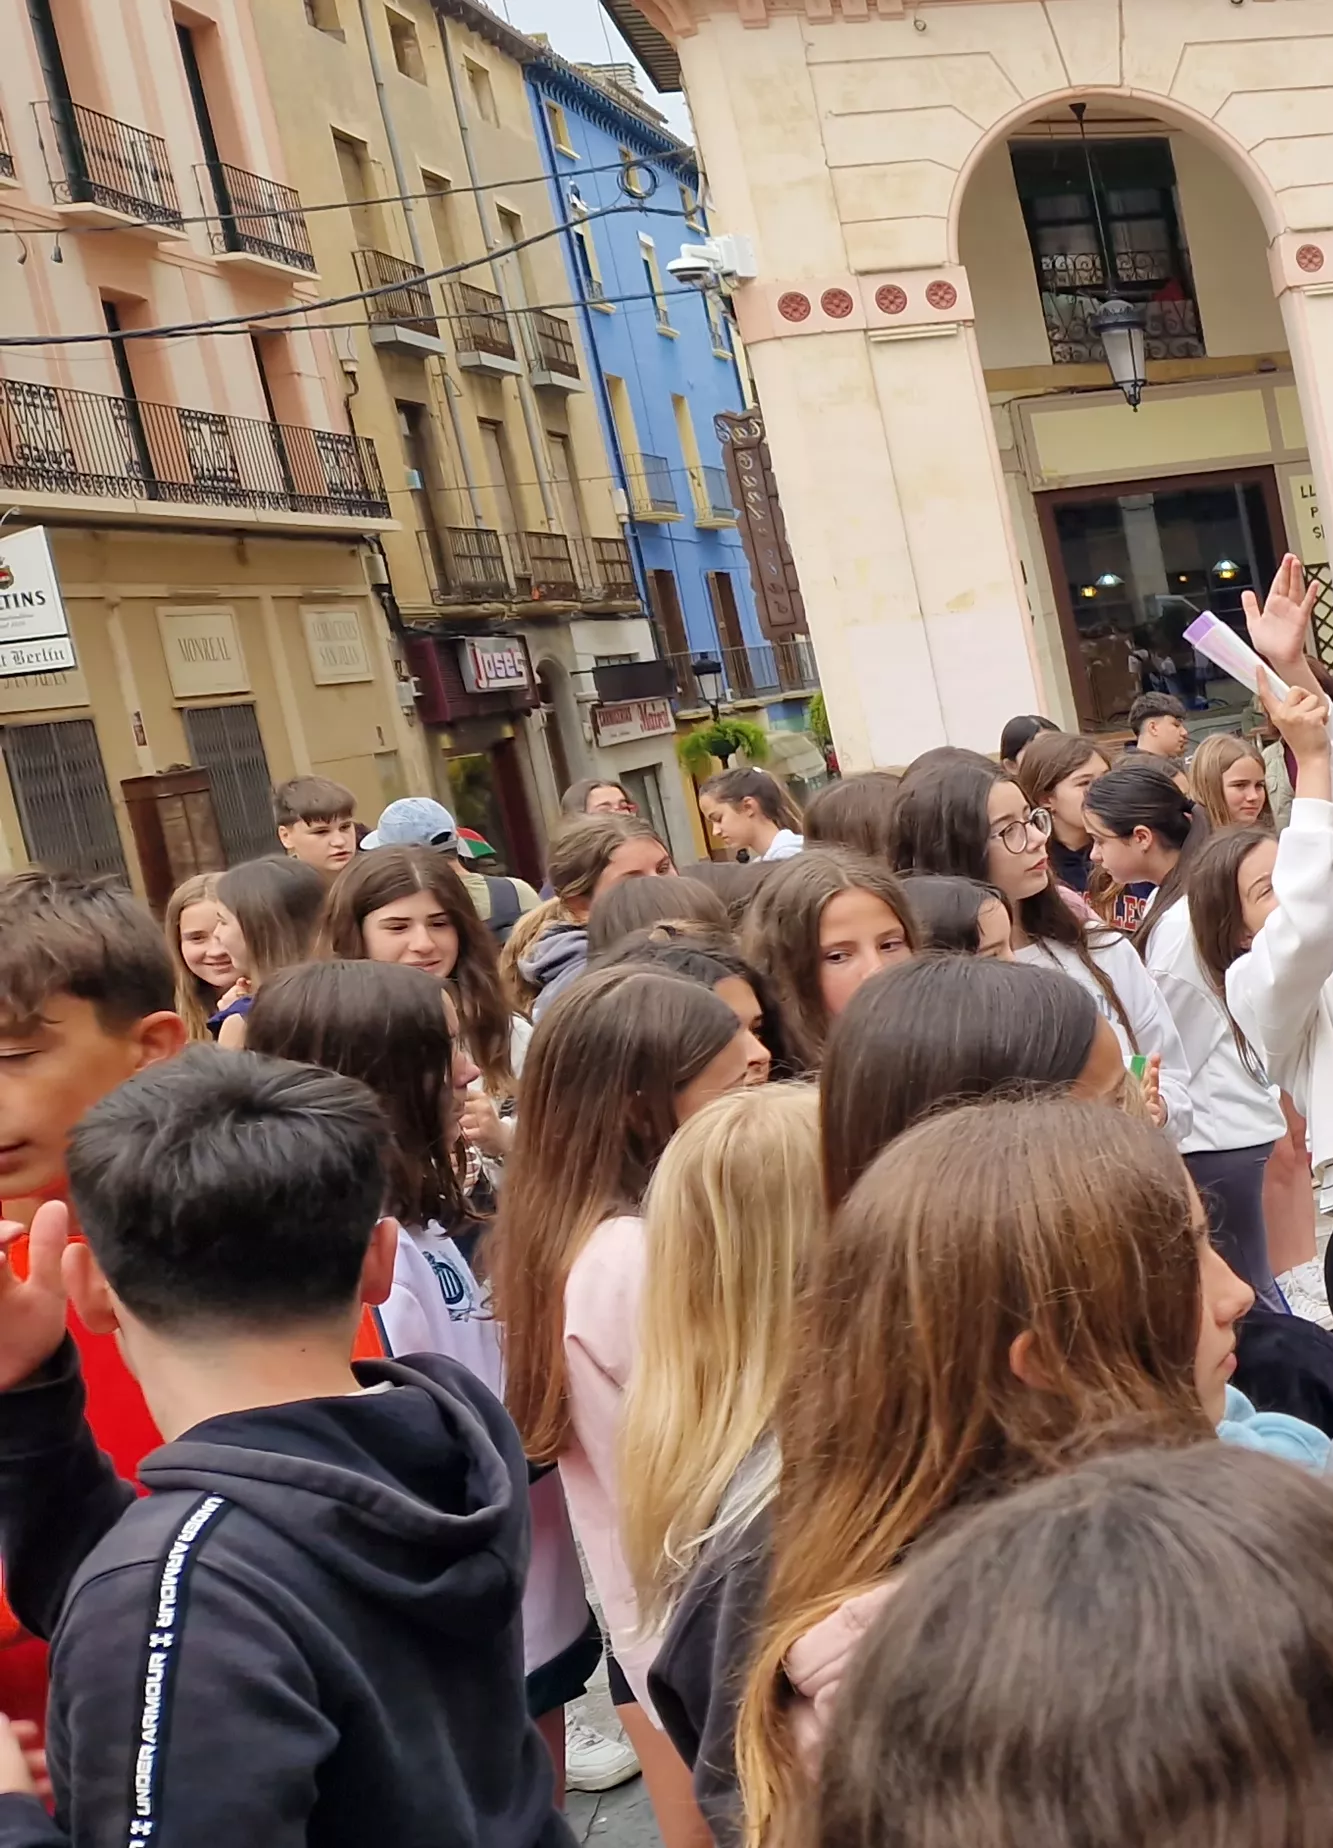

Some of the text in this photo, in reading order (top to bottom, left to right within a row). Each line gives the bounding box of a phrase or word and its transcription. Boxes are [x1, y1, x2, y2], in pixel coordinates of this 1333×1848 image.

[1300, 484, 1316, 498] LL
[177, 636, 232, 662] MONREAL
[155, 1496, 225, 1628] UNDER ARMOUR
[141, 1652, 168, 1744] ARMOUR
[135, 1744, 157, 1816] UNDER
